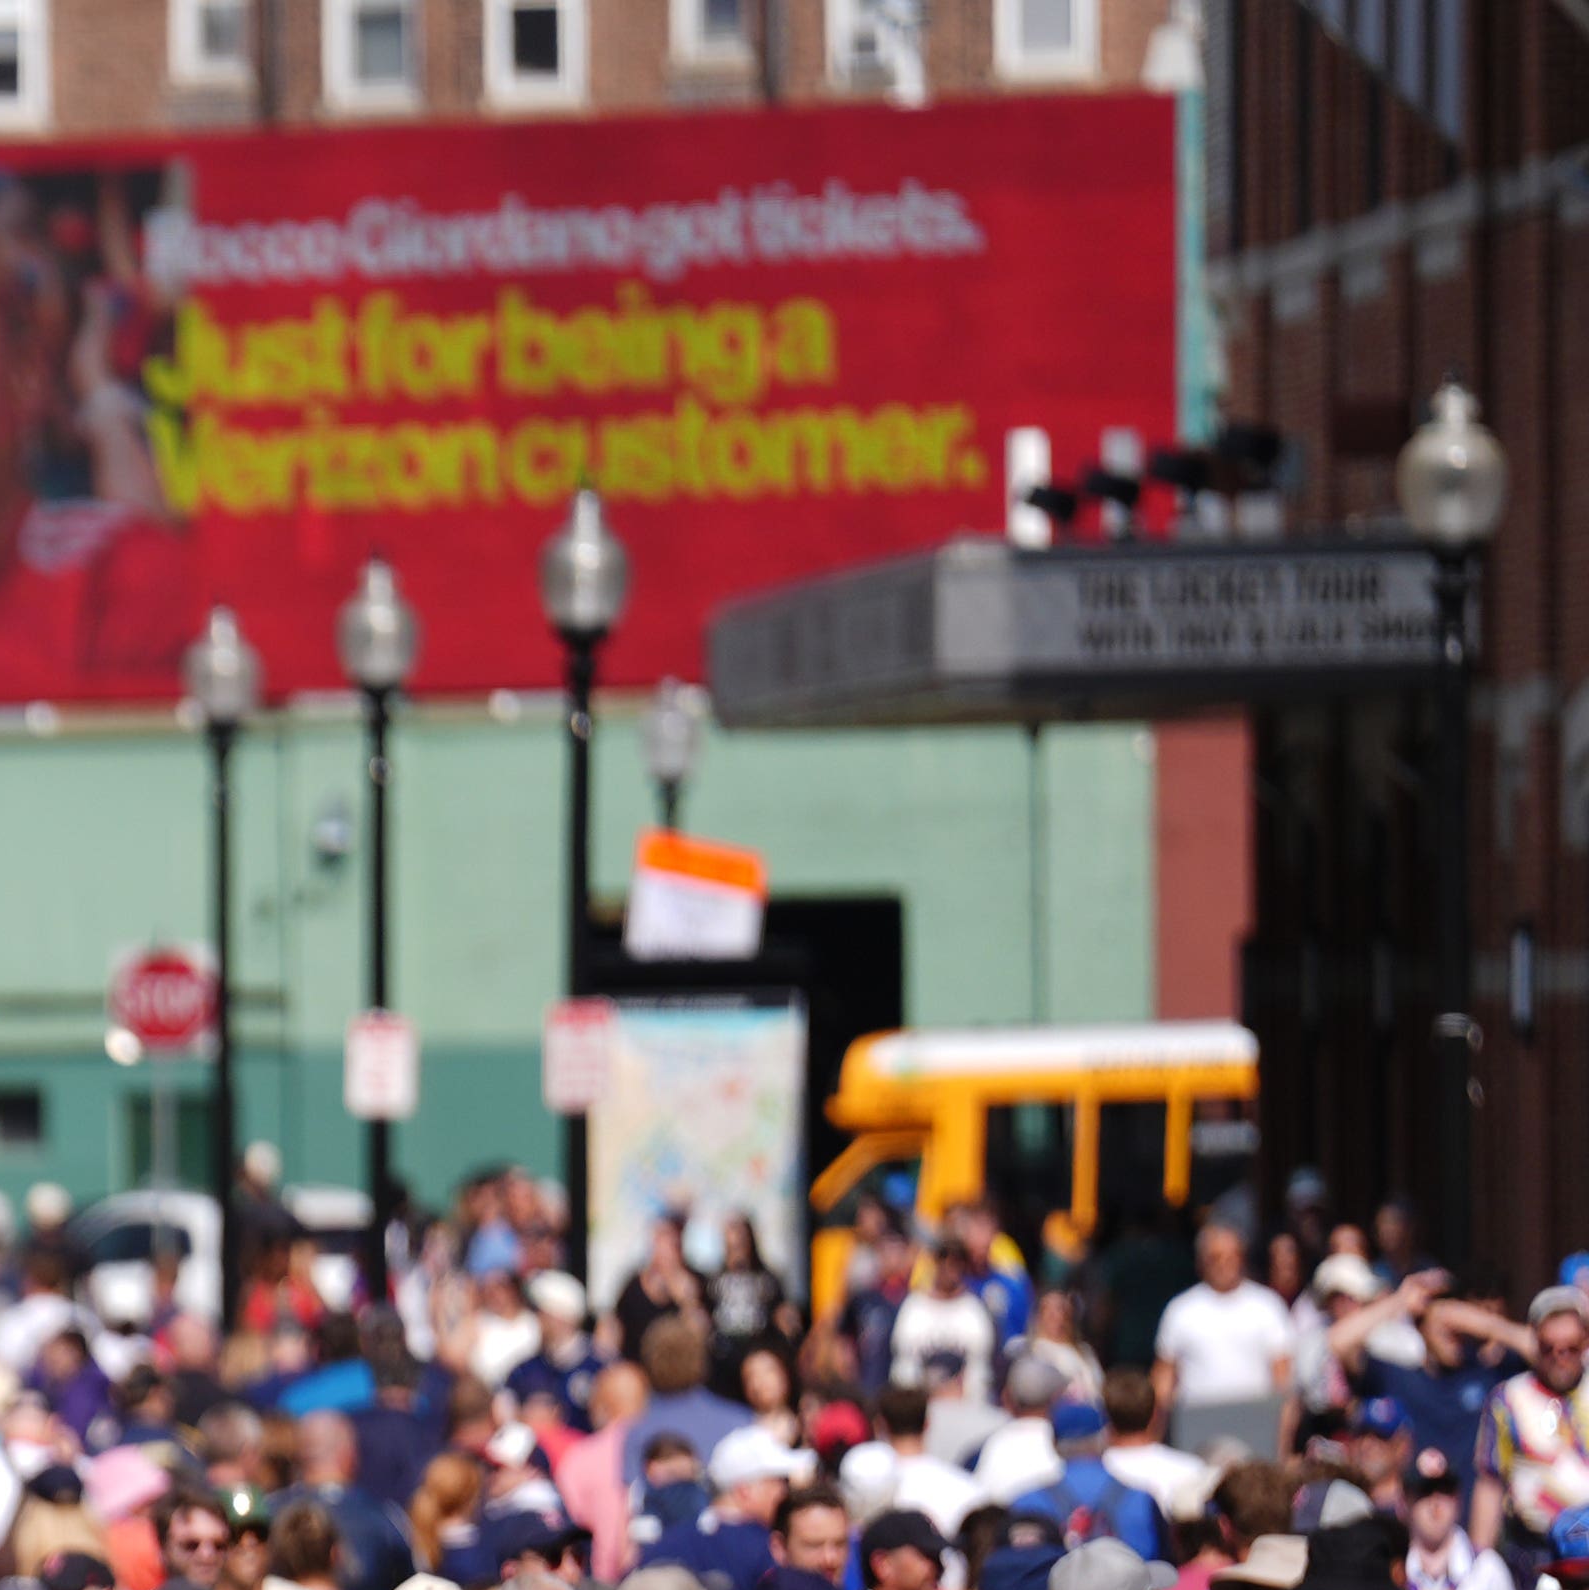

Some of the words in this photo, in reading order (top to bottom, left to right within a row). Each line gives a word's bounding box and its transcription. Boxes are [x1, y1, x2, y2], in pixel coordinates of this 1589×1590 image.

[142, 293, 346, 398] Just
[357, 289, 491, 396] for
[499, 281, 765, 404] being
[773, 296, 837, 385] a
[142, 405, 500, 512] Verizon
[509, 396, 986, 505] customer.
